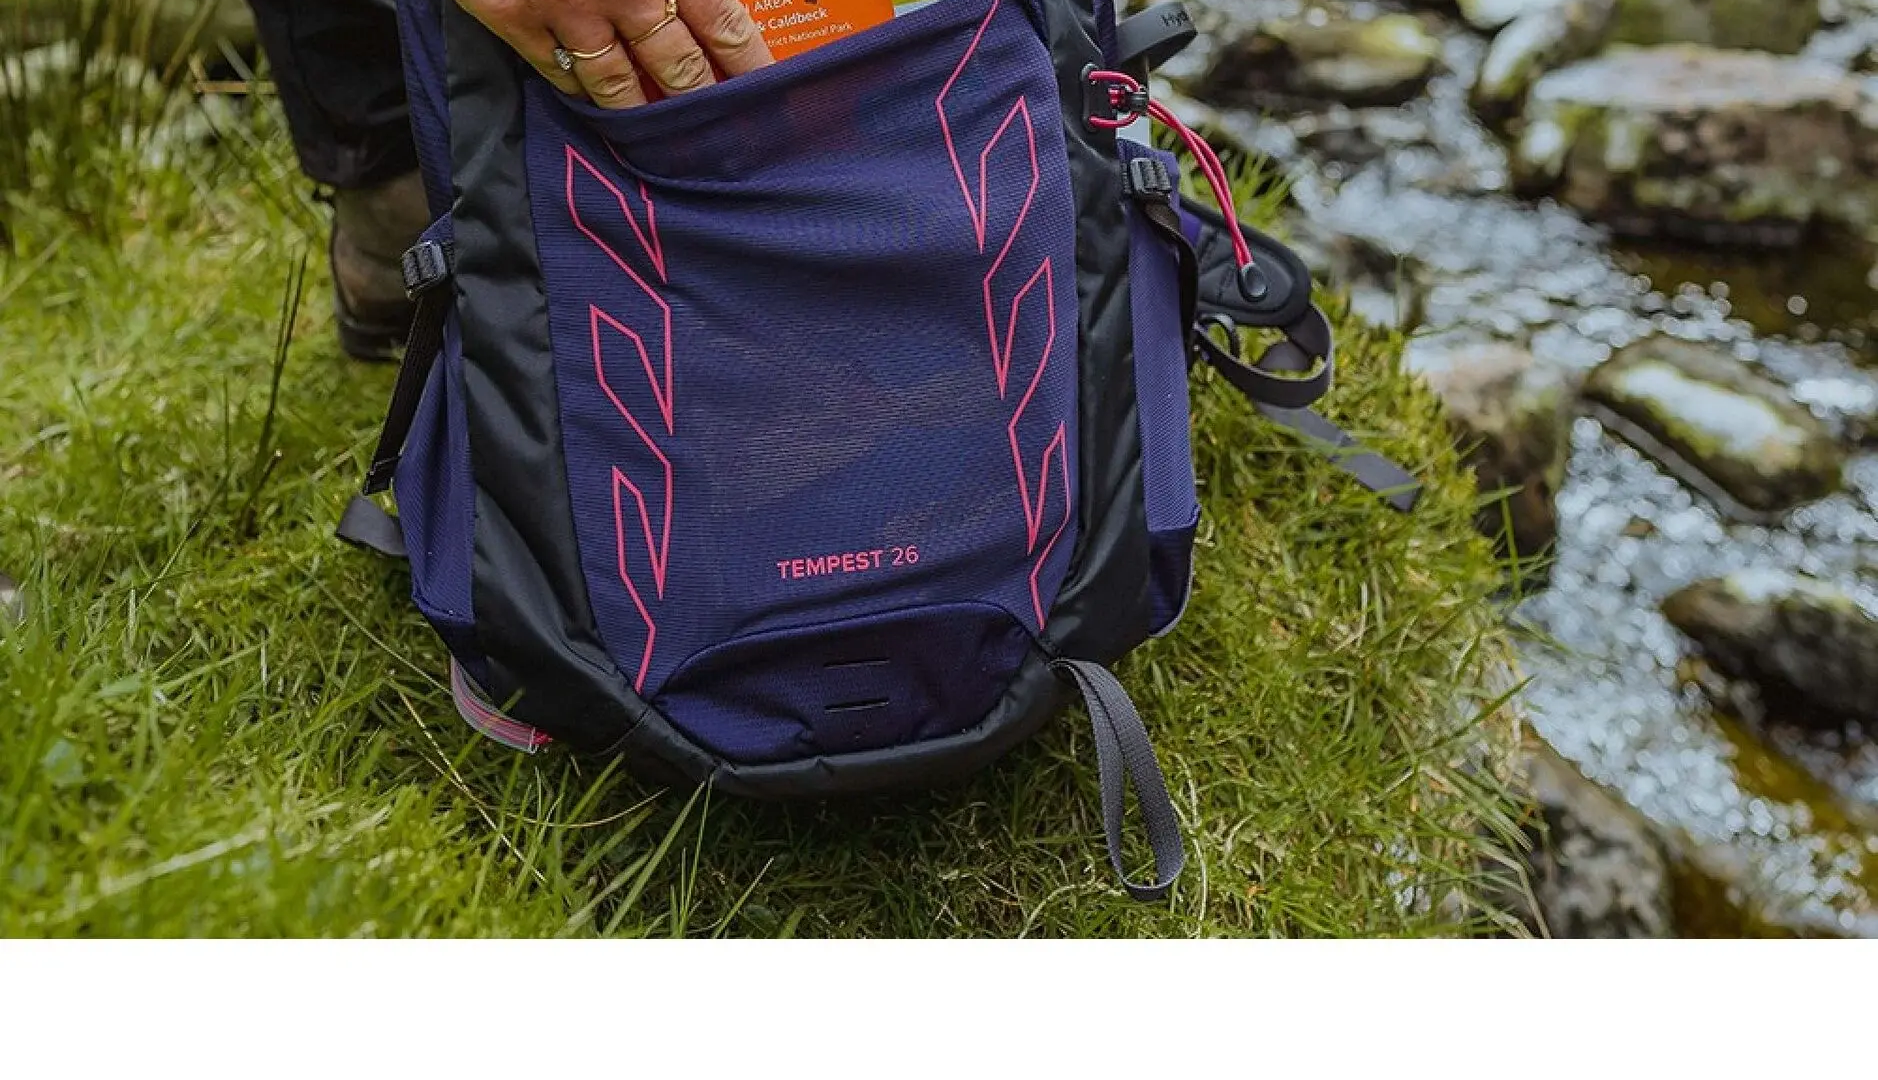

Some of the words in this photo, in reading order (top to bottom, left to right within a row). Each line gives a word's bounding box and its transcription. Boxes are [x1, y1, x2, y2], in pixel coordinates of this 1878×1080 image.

[767, 7, 829, 30] Caldbeck
[767, 35, 788, 48] trict
[788, 25, 830, 43] National
[830, 21, 854, 34] Park
[777, 549, 884, 579] TEMPEST
[891, 544, 920, 567] 26
